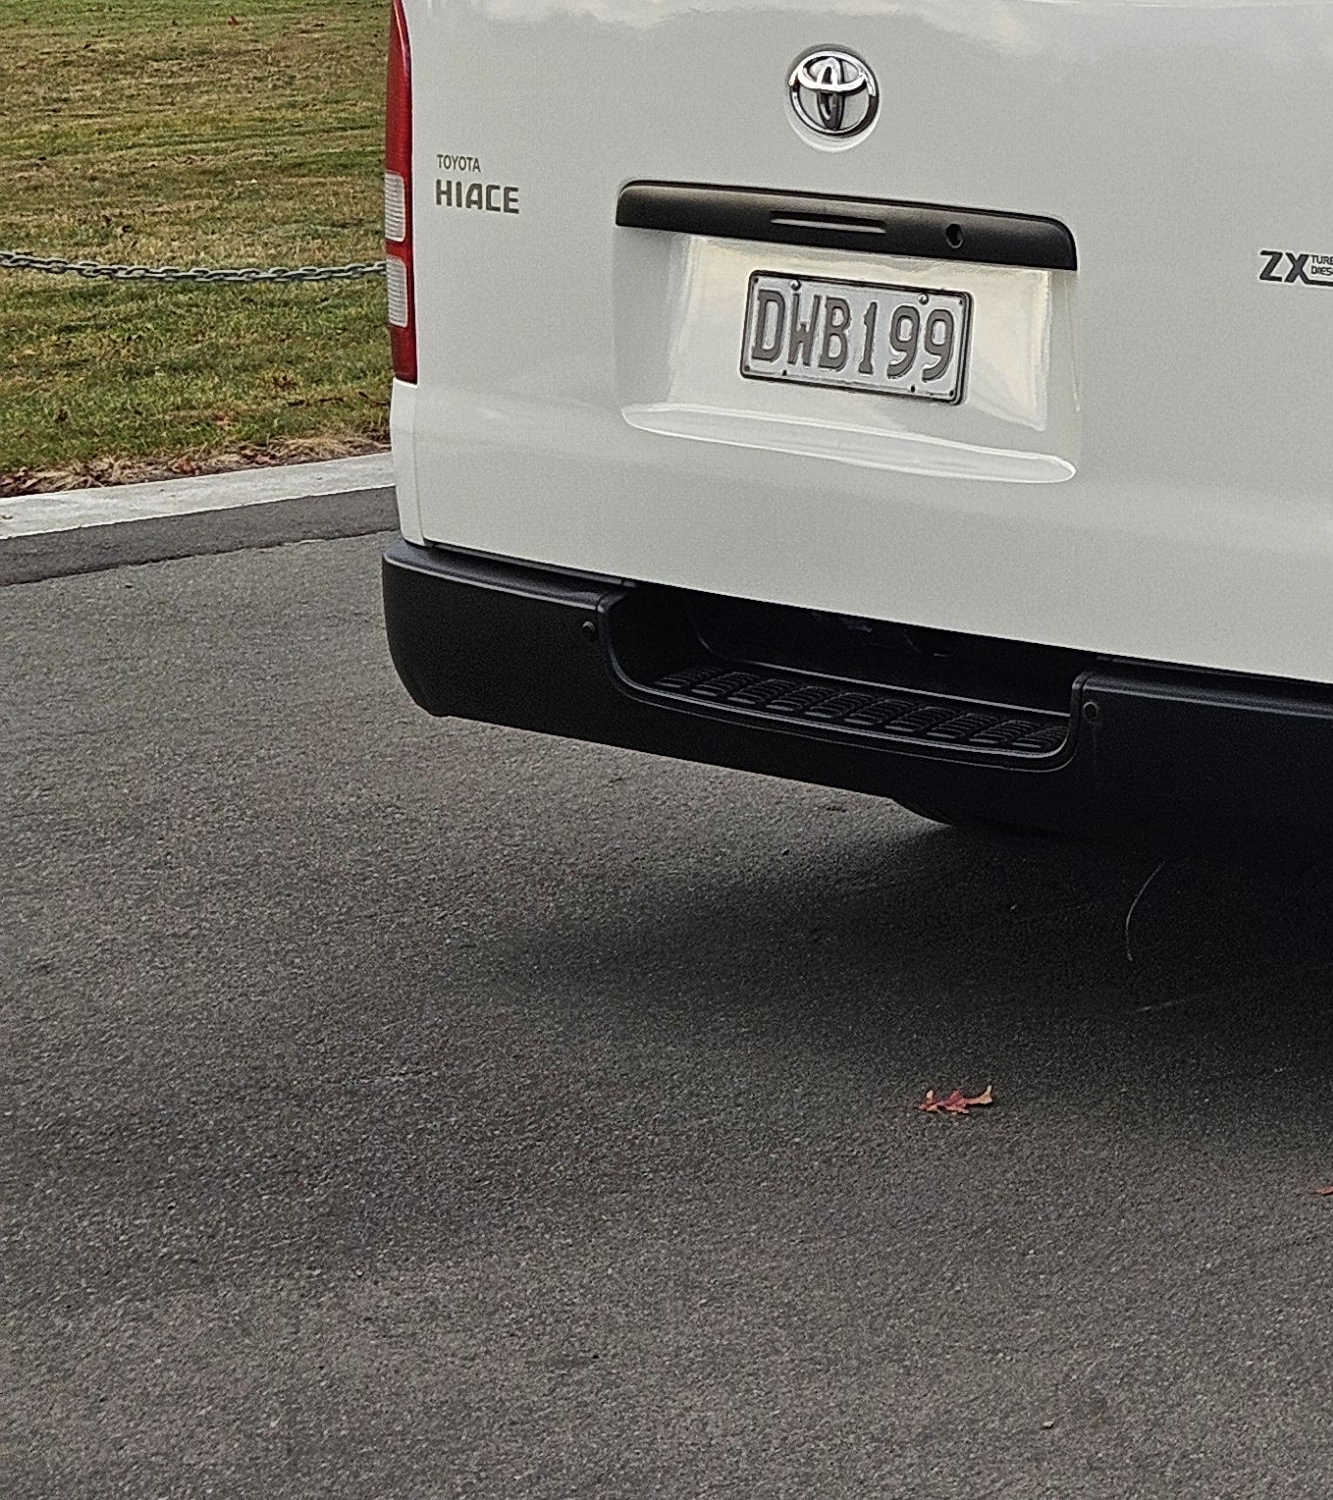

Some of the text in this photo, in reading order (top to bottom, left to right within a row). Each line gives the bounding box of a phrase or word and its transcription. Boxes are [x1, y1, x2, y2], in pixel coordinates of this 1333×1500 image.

[437, 154, 481, 172] TOYOTA
[436, 179, 519, 214] HIACE
[1260, 250, 1312, 284] ZX
[751, 289, 955, 382] DWB199
